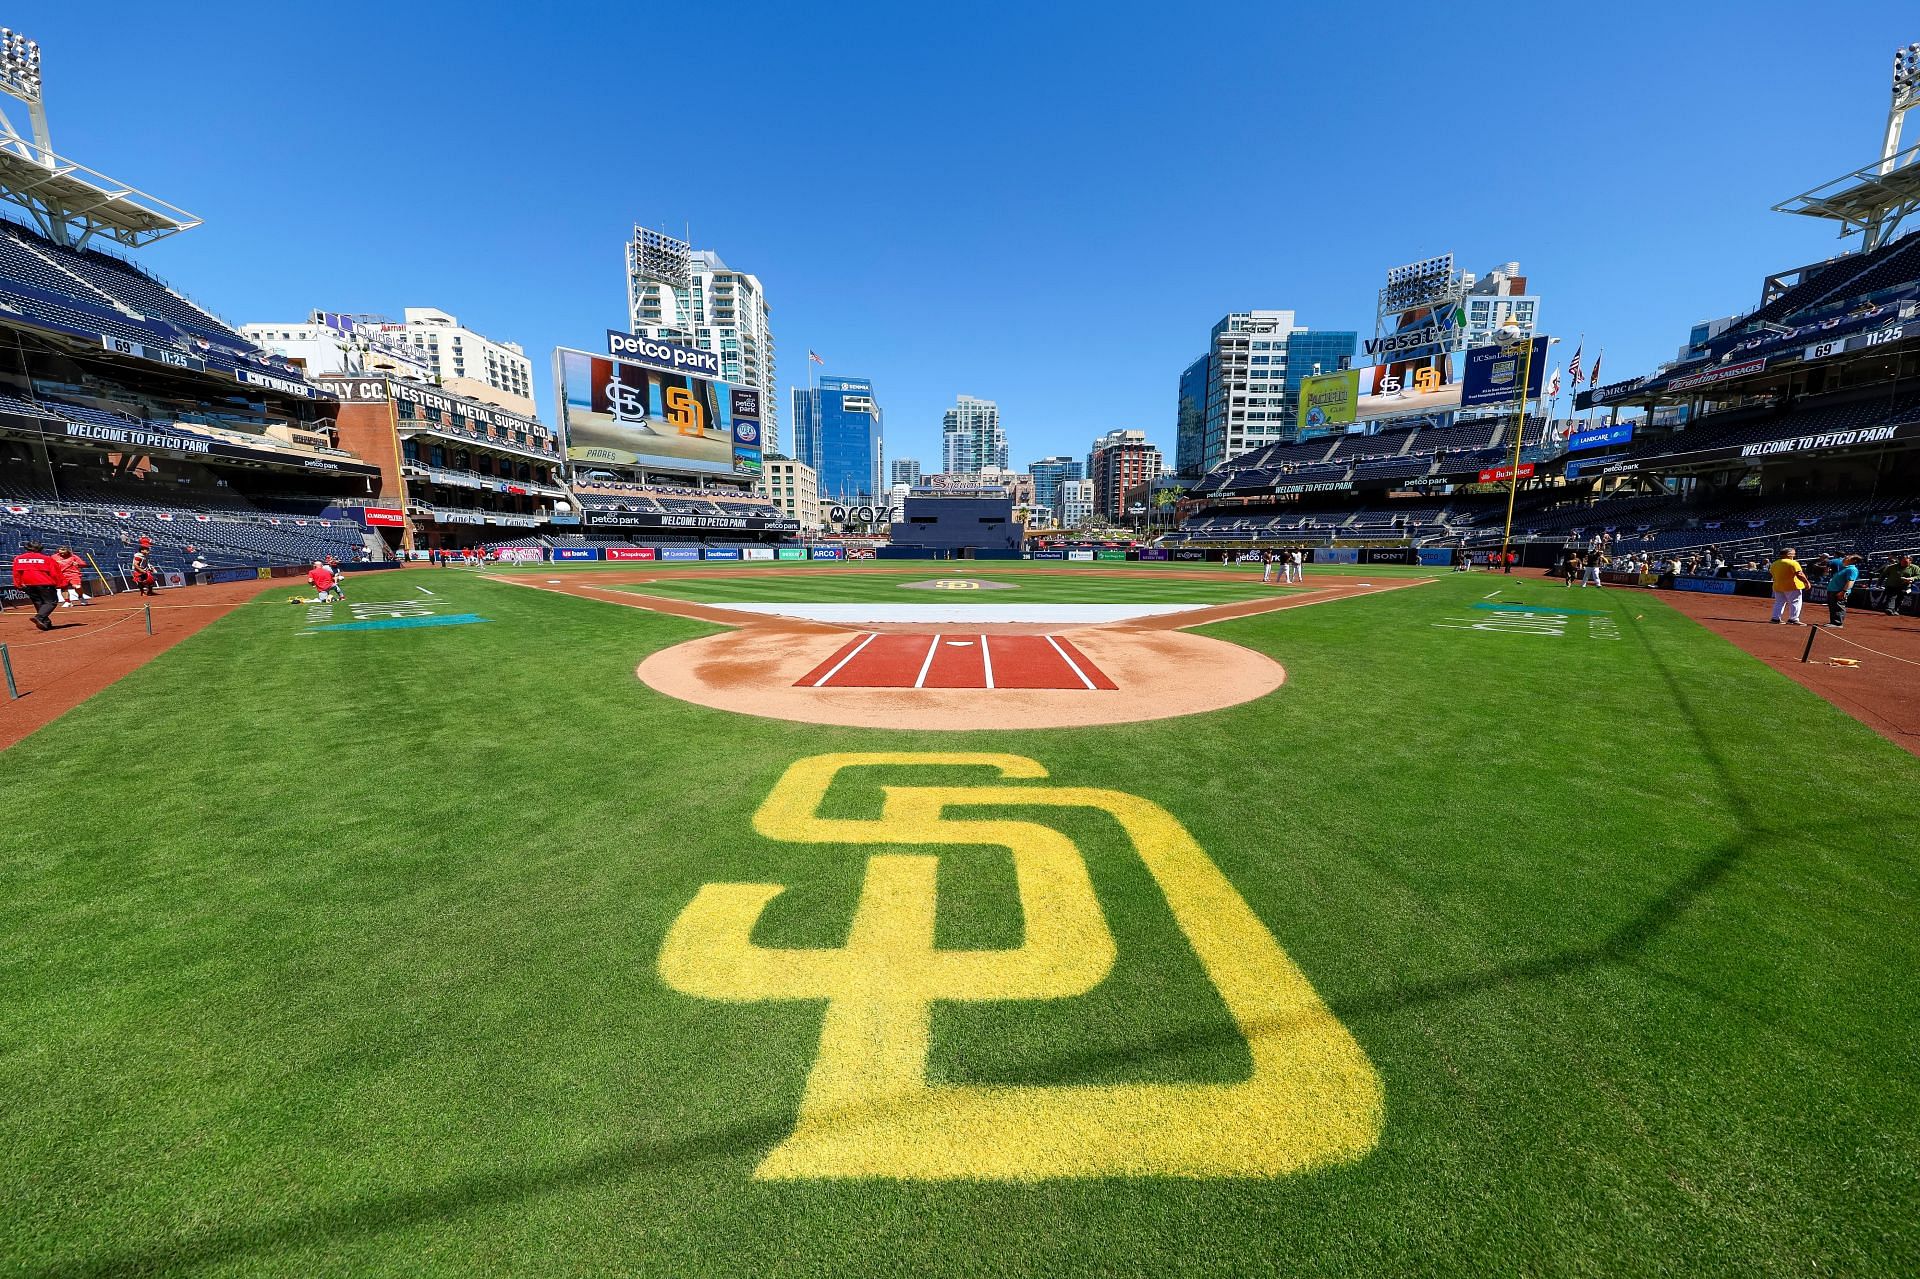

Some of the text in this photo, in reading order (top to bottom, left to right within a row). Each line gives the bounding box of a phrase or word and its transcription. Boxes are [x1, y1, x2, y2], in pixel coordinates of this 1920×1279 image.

[1866, 326, 1903, 346] 11:25
[160, 350, 188, 366] 11:25
[610, 334, 717, 371] petco park
[1719, 363, 1762, 379] SAUSAGES
[389, 381, 548, 438] WESTERN METAL SUPPLY CO.
[66, 422, 209, 453] WELCOME TO PETCO PARK
[1580, 433, 1609, 444] LANDCARE
[1741, 425, 1899, 457] WELCOME TO PETCO PARK
[586, 448, 616, 461] PADRES
[1603, 463, 1639, 474] petco park
[1275, 481, 1354, 494] WELCOME TO PETCO PARK
[1404, 477, 1448, 488] petco park
[591, 515, 640, 525] petco park
[661, 515, 747, 528] WELCOME TO PETCO PARK
[849, 507, 899, 523] razr
[764, 521, 798, 530] petco park
